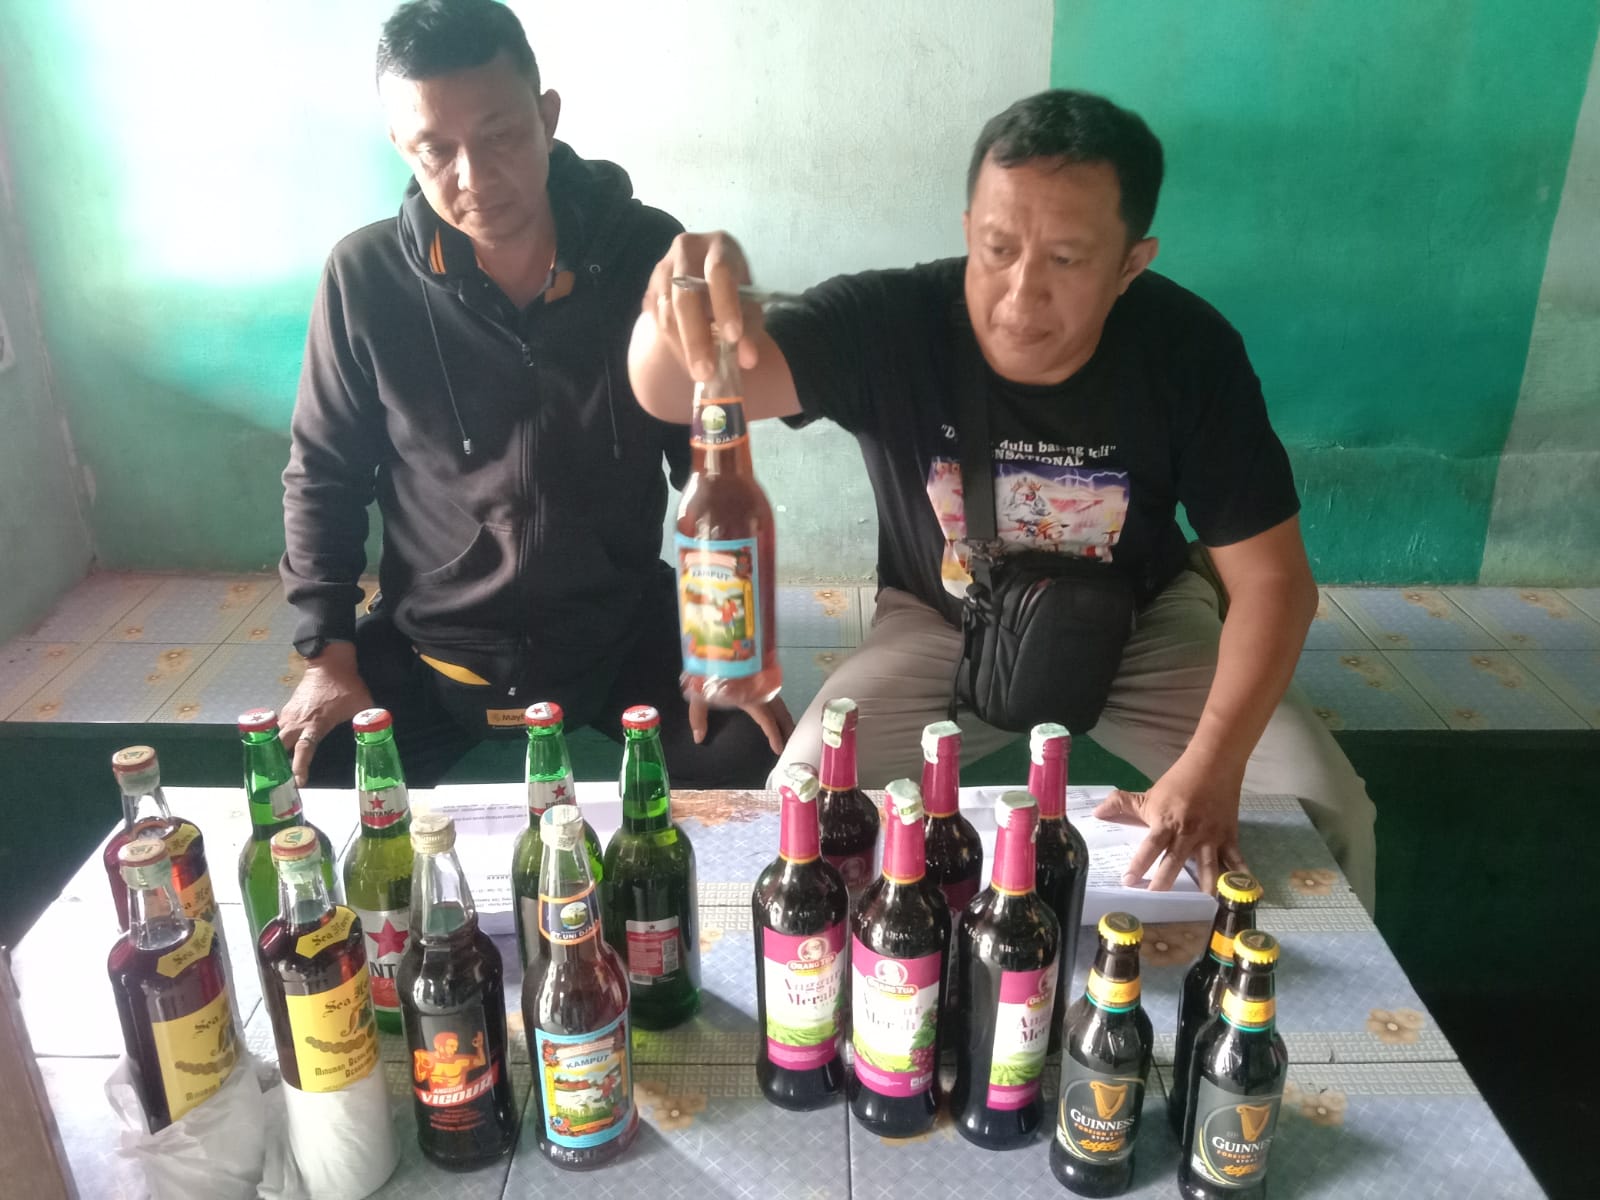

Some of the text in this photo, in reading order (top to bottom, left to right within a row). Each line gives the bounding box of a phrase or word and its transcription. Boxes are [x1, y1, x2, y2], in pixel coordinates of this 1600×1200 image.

[1000, 439, 1033, 453] dulu
[566, 1054, 609, 1070] KAMPUT
[1070, 1108, 1135, 1130] GUINNESS
